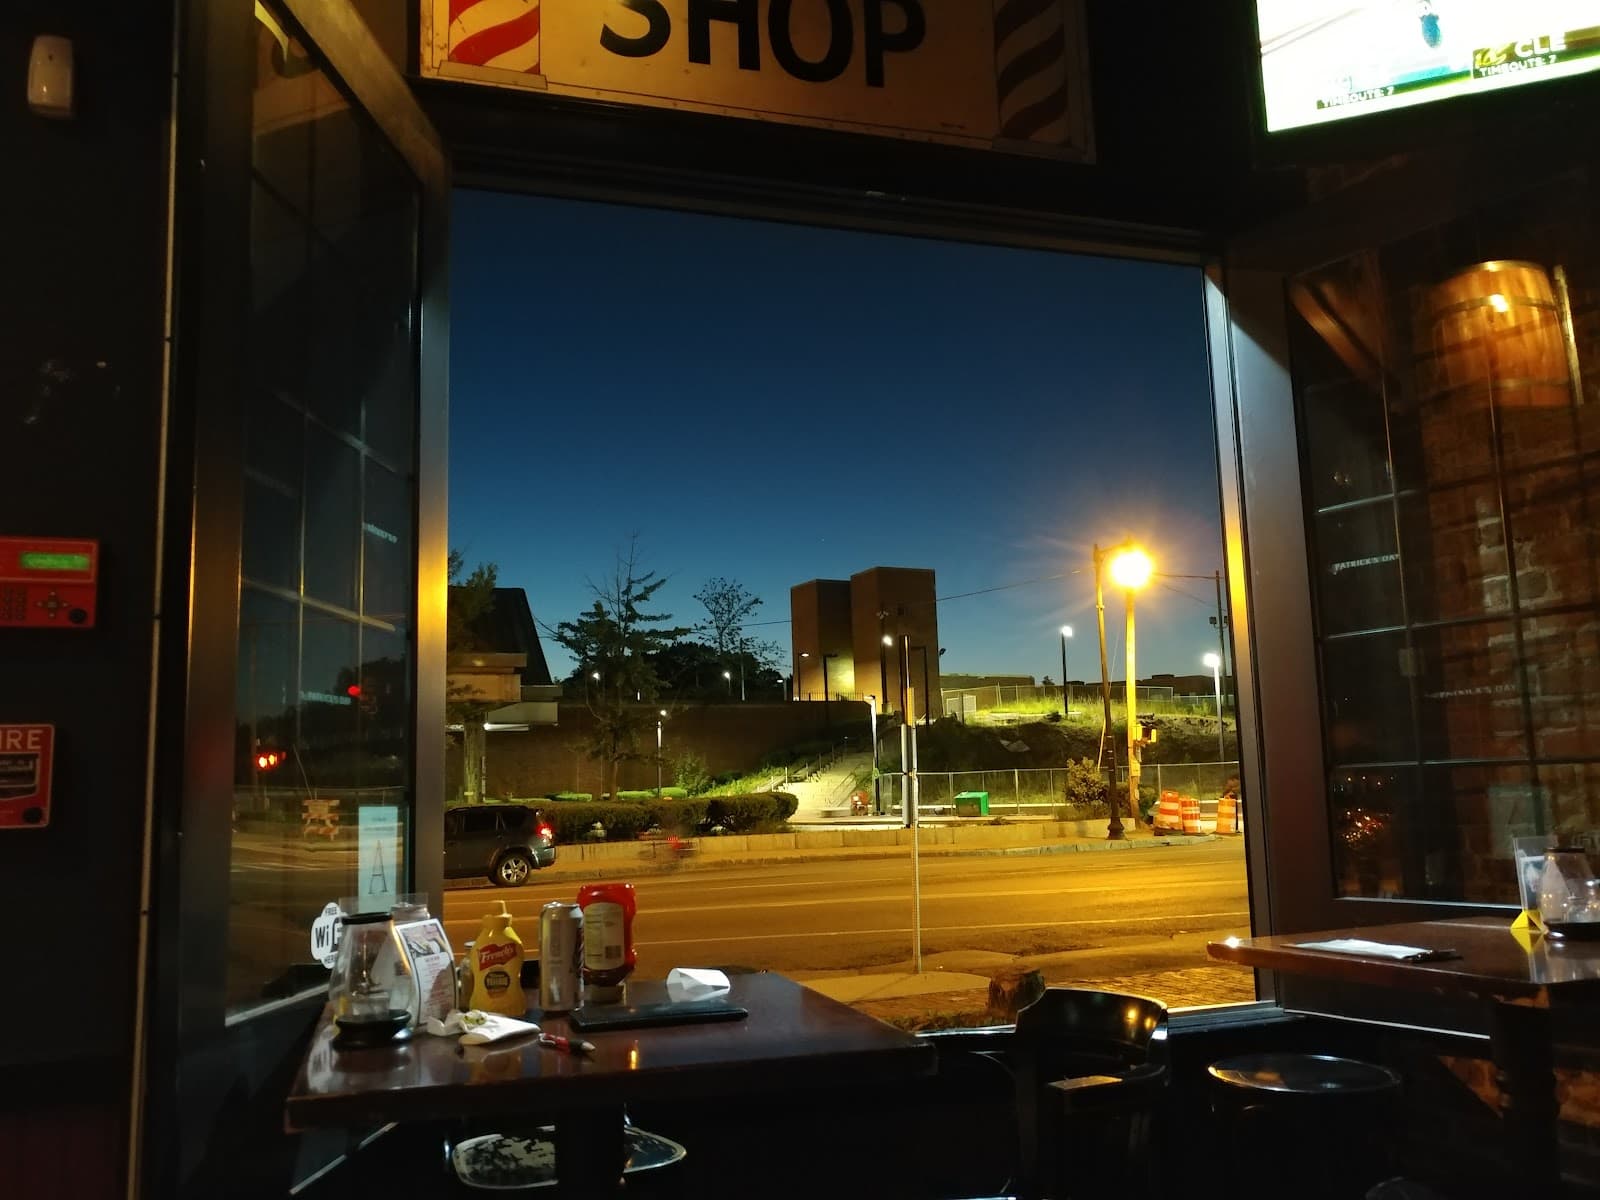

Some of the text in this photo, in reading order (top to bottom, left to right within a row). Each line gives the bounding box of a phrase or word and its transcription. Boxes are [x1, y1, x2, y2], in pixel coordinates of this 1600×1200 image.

[600, 0, 926, 88] SHOP
[1514, 32, 1566, 57] CLE
[1548, 55, 1557, 64] 7
[1386, 86, 1394, 96] 7
